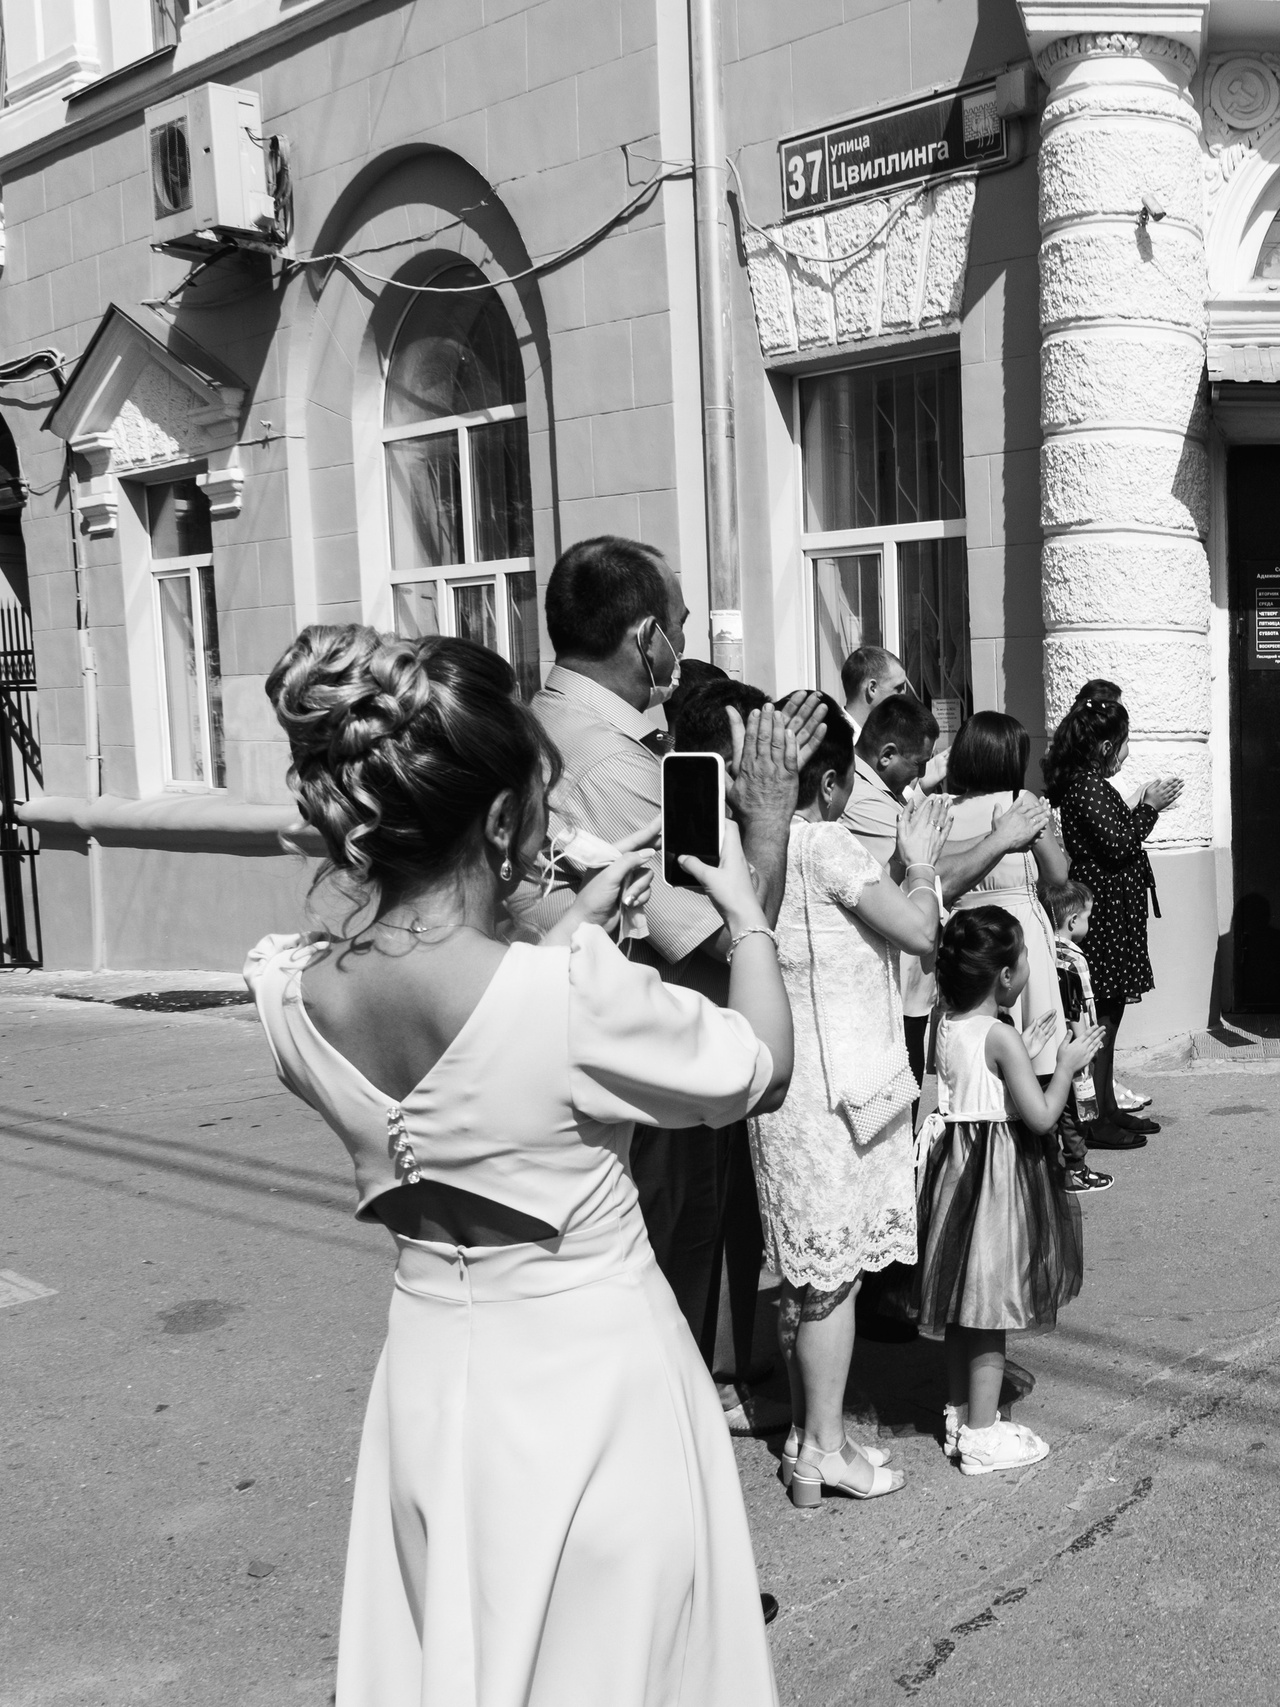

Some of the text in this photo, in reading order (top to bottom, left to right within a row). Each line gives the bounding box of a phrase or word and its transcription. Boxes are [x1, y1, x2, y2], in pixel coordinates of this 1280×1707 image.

[830, 133, 870, 161] улица
[832, 140, 949, 191] Цвиллинга
[787, 149, 823, 200] 37
